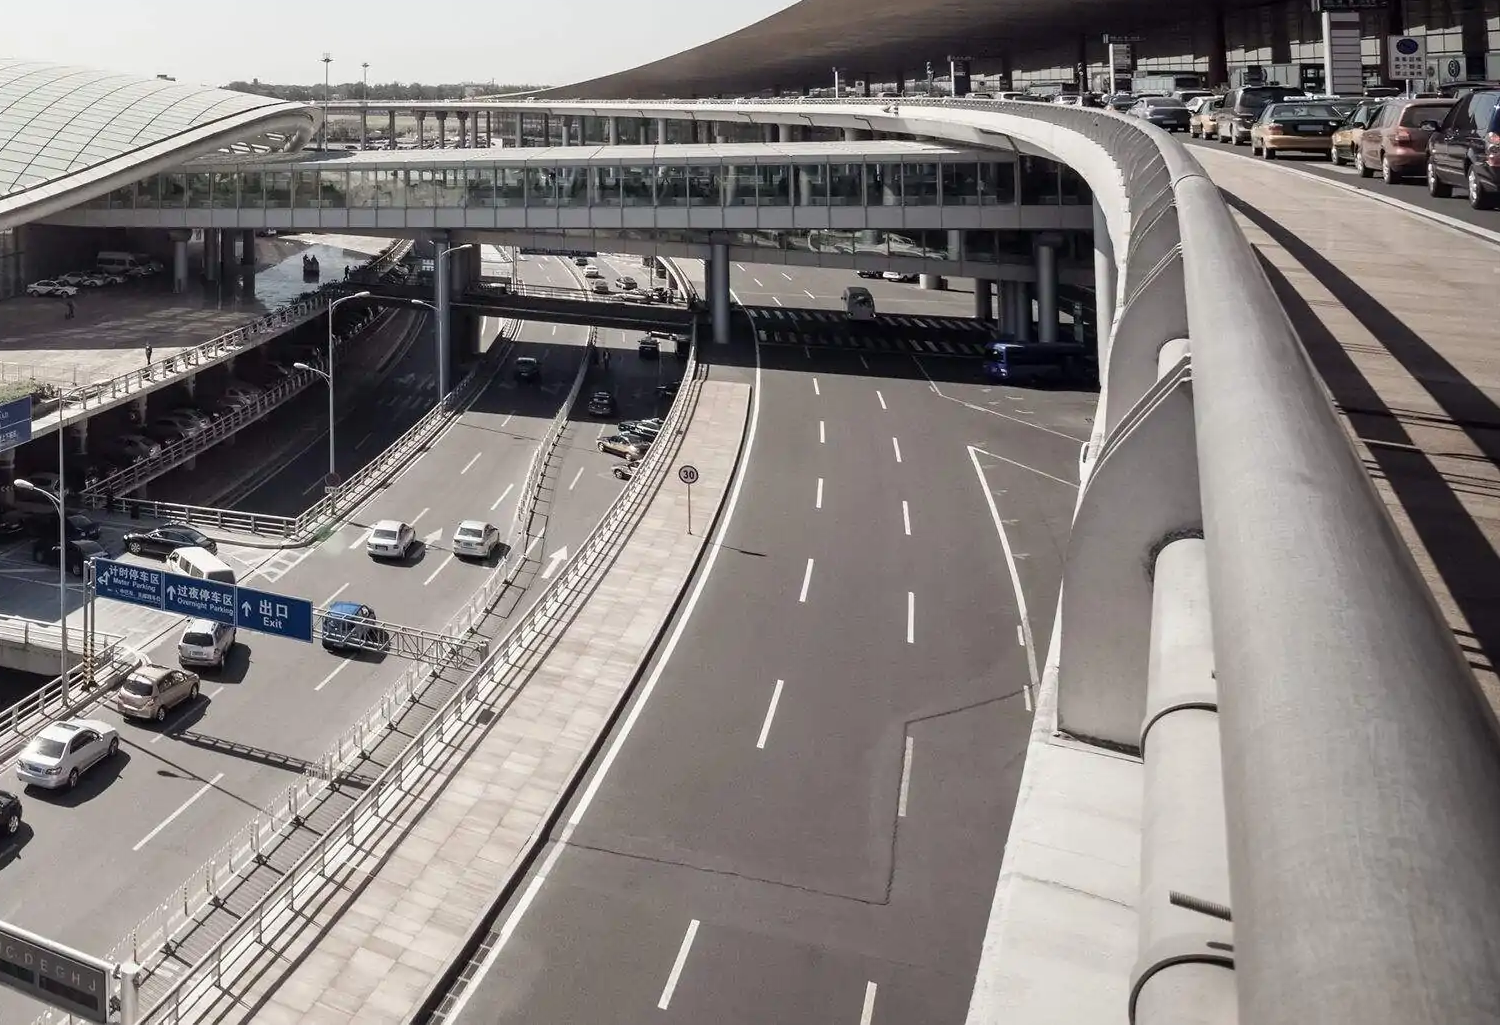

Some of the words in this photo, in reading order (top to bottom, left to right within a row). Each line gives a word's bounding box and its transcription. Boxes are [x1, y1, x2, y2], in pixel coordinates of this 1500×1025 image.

[683, 470, 695, 480] 30
[108, 564, 160, 585] 计时停车区
[132, 580, 157, 593] Parking
[176, 584, 234, 607] 过夜停车区
[177, 597, 208, 611] Overnight
[209, 603, 234, 617] Parking
[259, 599, 288, 619] 出口
[263, 616, 283, 629] Exit
[24, 952, 33, 965] D
[40, 958, 48, 973] E
[56, 966, 65, 978] G
[72, 971, 81, 986] H
[89, 980, 96, 991] J
